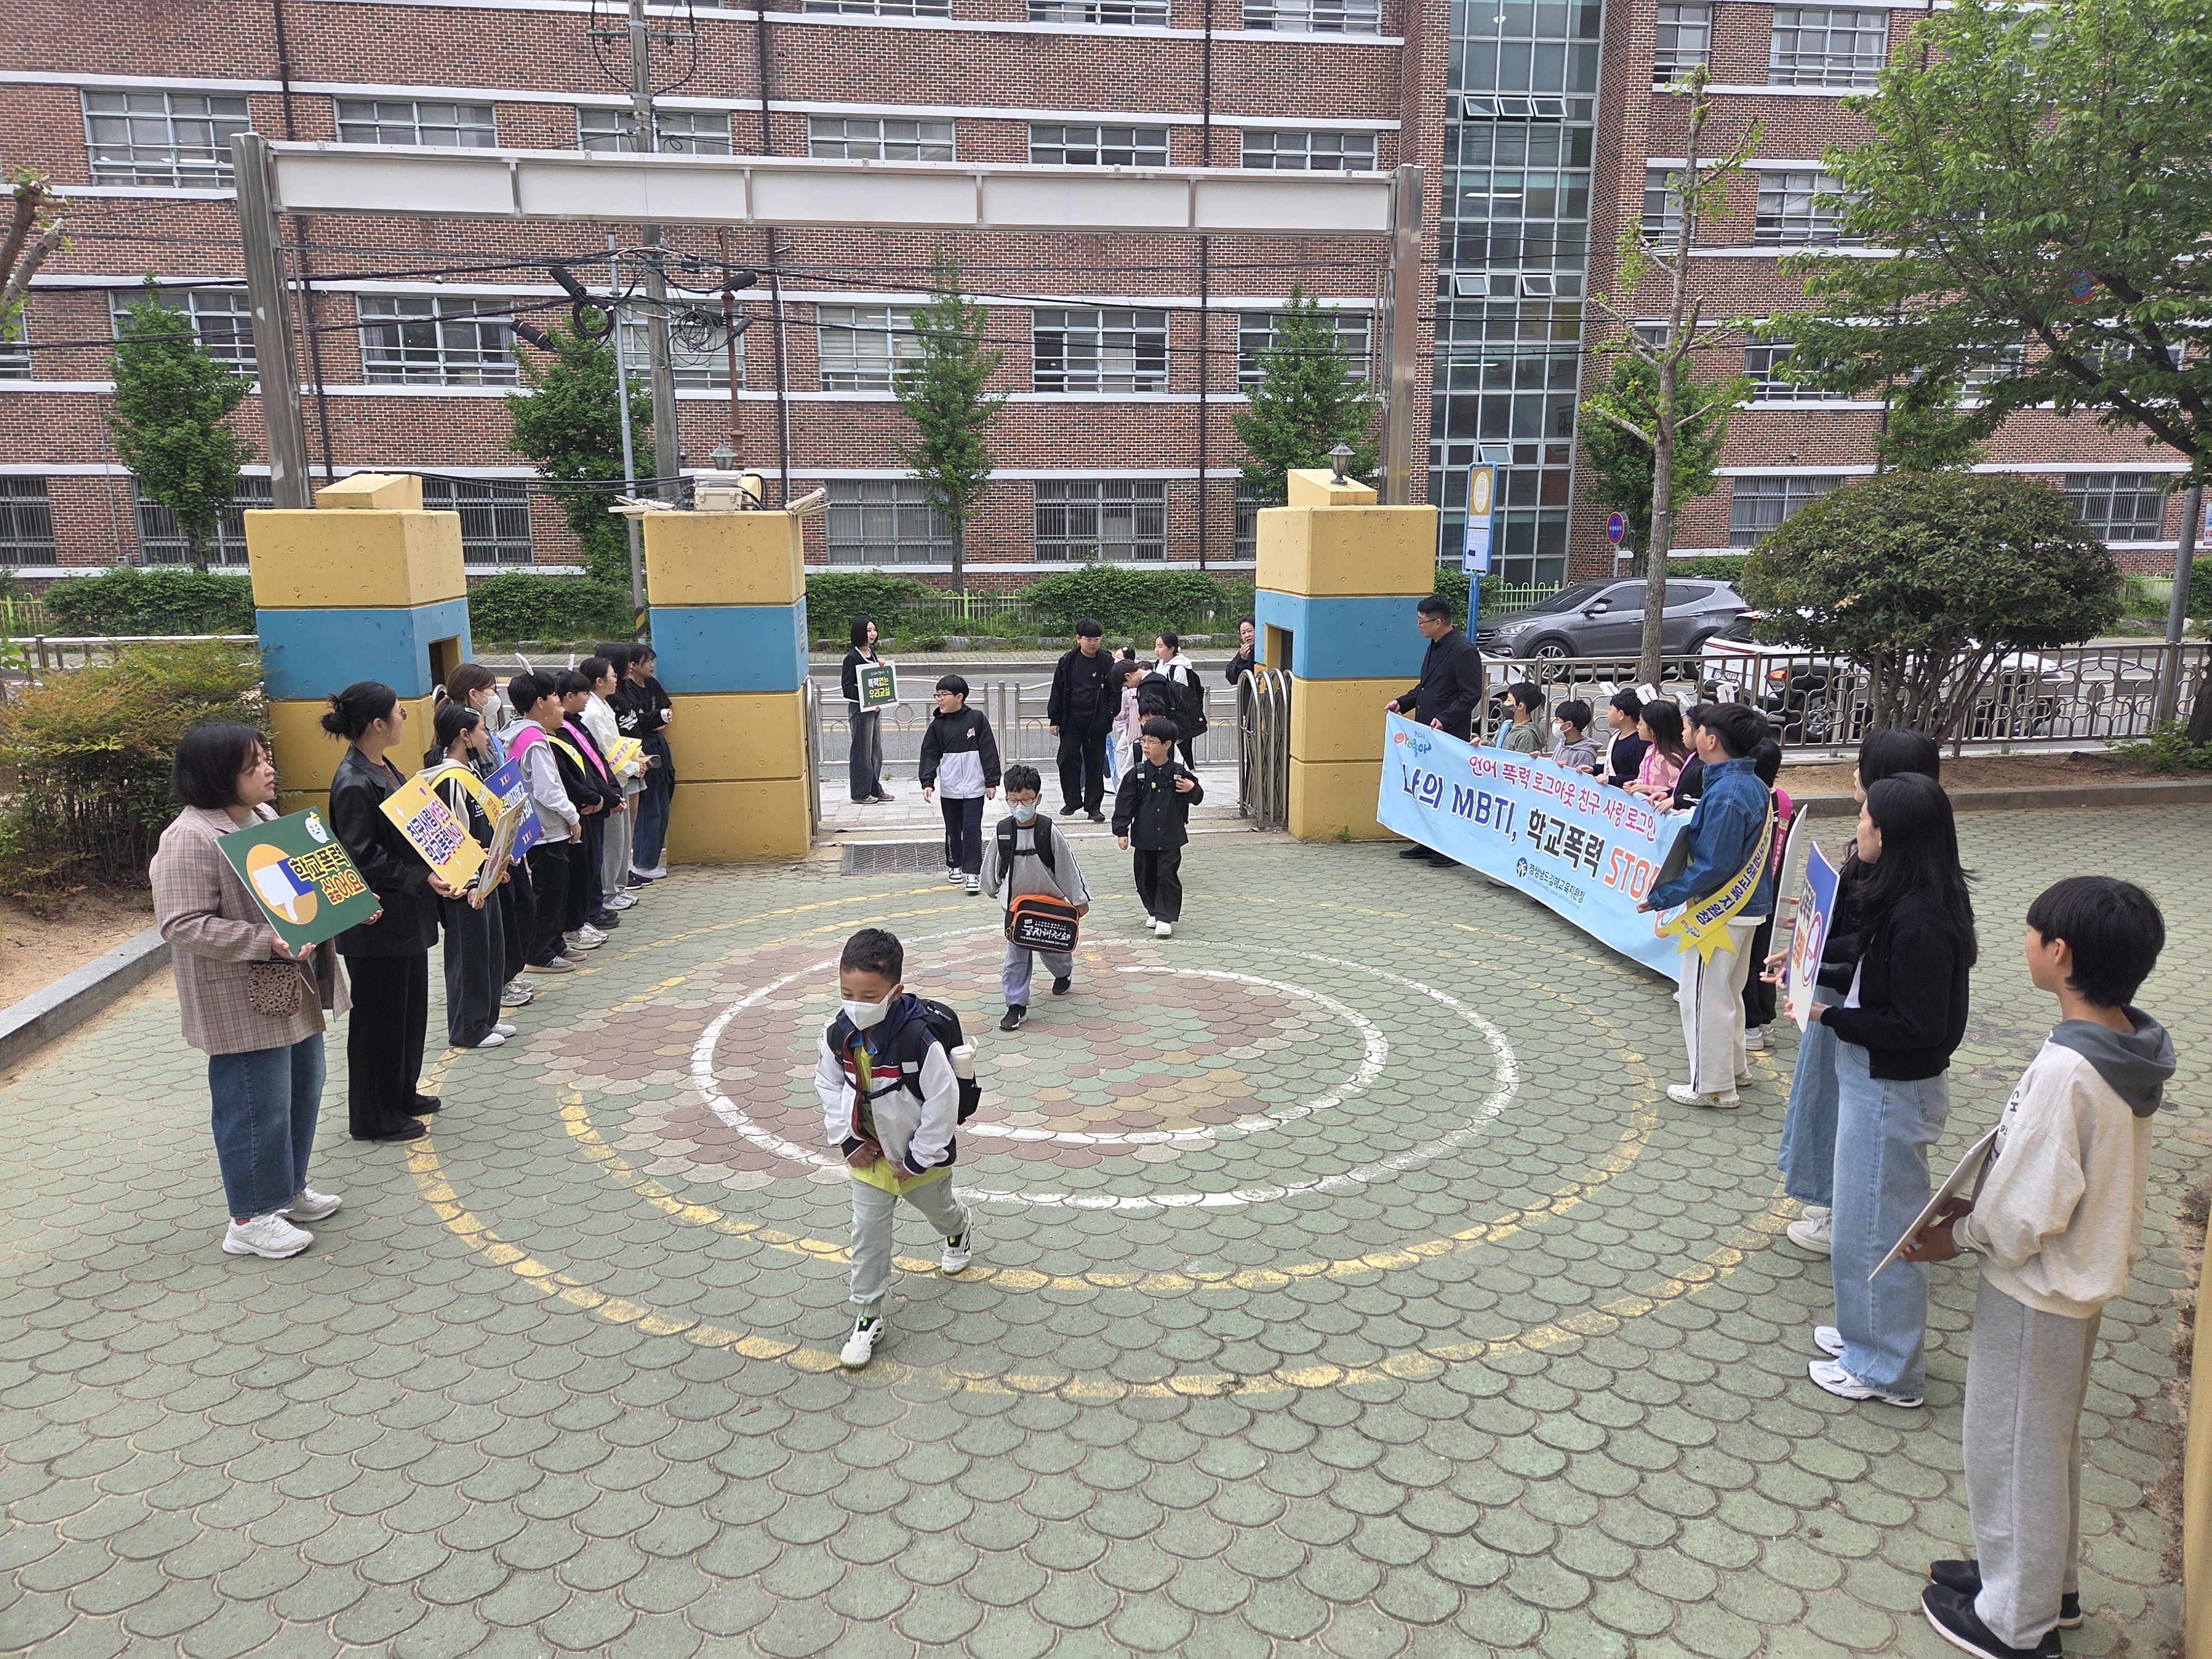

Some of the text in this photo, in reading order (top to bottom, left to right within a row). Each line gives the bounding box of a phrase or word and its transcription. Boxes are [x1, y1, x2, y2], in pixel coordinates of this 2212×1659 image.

[869, 686, 890, 699] 우리교실
[429, 800, 447, 821] YES
[1469, 755, 1656, 842] 언어 폭력 로그아웃 친구 사랑 로그인
[1402, 764, 1443, 809] 나의
[1452, 784, 1517, 842] MBTI,
[1527, 808, 1605, 878] 학교폭력
[425, 822, 462, 862] 학교폭력 NO
[289, 844, 350, 880] 학교폭력
[321, 870, 366, 904] 싫어요
